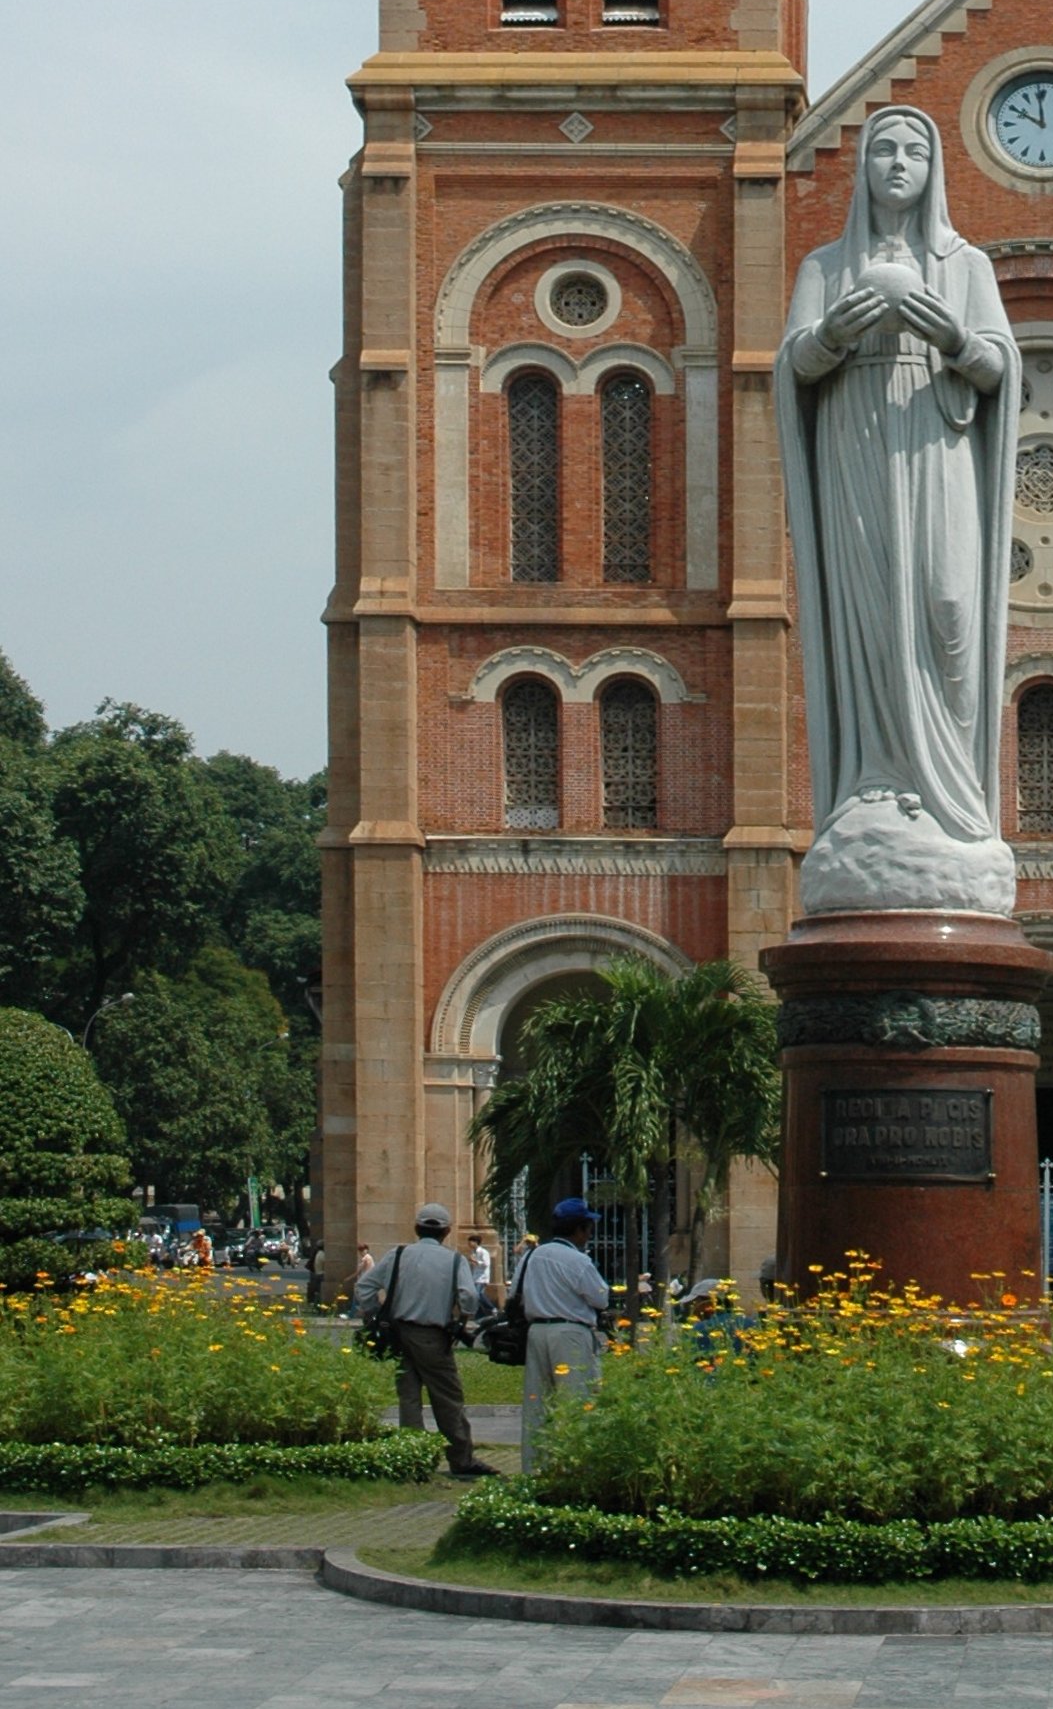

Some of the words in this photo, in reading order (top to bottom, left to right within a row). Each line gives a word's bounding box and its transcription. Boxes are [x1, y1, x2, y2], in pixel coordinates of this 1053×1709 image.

[833, 1126, 871, 1147] ORA
[875, 1126, 919, 1148] PRO
[924, 1126, 985, 1150] NOBIS
